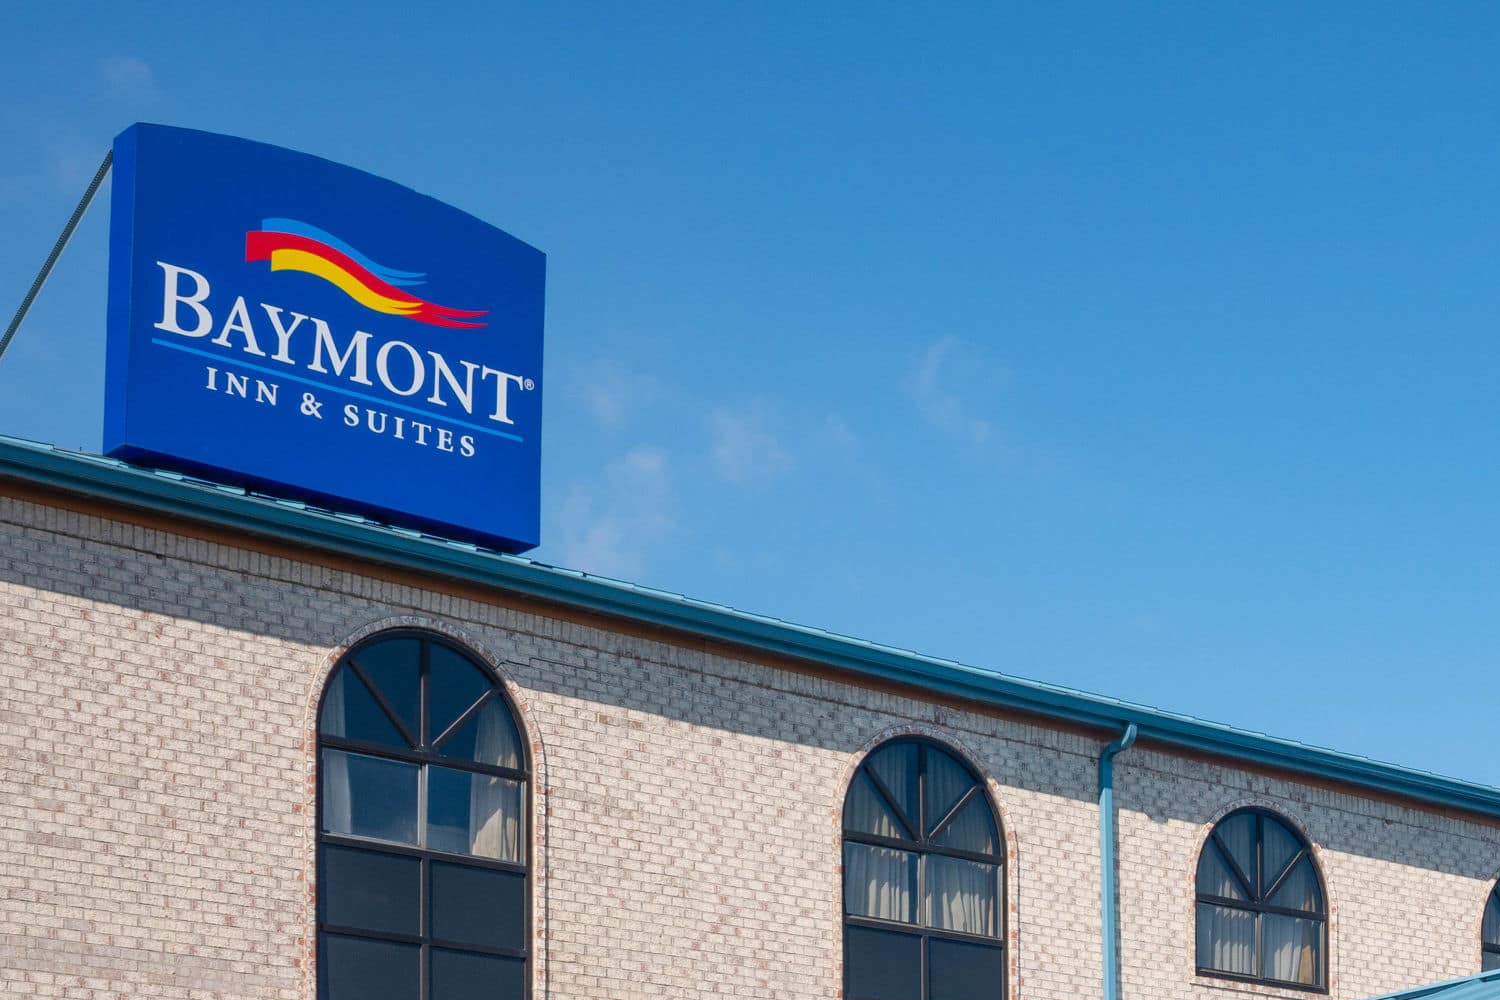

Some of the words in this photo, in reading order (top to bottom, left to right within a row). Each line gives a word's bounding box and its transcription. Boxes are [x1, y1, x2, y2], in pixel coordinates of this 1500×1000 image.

[206, 366, 279, 406] INN
[300, 392, 323, 419] &
[343, 404, 475, 457] SUITES
